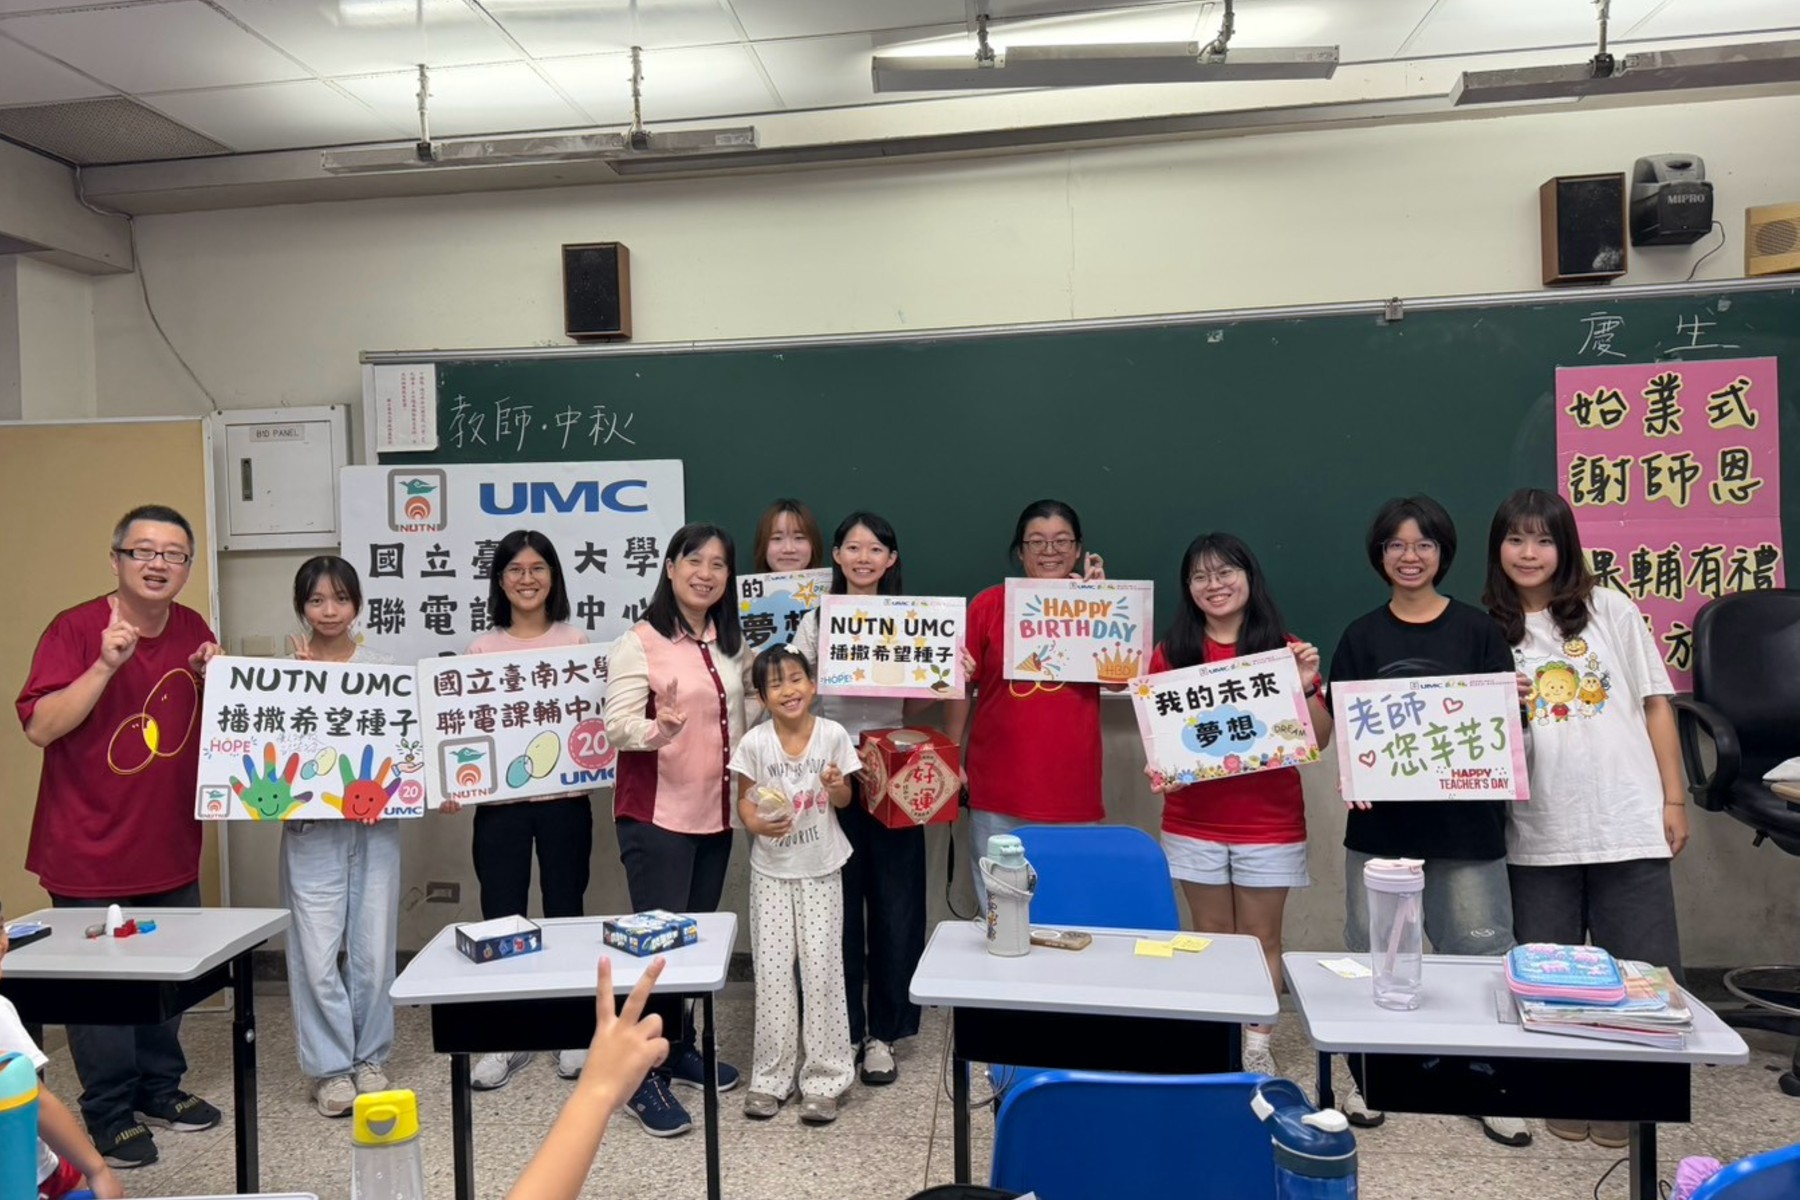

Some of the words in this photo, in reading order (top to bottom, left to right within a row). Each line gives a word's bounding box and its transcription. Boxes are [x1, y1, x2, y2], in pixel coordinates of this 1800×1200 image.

[1667, 193, 1706, 205] MIPRO
[1569, 372, 1757, 434] 始業式
[272, 428, 300, 439] PANEL
[1569, 448, 1763, 504] 謝師恩
[479, 479, 649, 515] UMC
[400, 523, 436, 533] NUTN
[368, 536, 660, 580] 國立臺大學
[1043, 597, 1113, 618] HAPPY
[831, 617, 894, 636] NUTN
[904, 618, 955, 637] UMC
[1019, 618, 1137, 643] BIRTHDAY
[230, 666, 328, 694] NUTN
[340, 671, 412, 697] UMC
[824, 674, 851, 684] HOPE
[1155, 672, 1280, 716] 我的未來
[217, 703, 418, 737] 播撒希望種子
[1348, 691, 1426, 740] 老師
[1194, 714, 1258, 749] 夢想
[1274, 724, 1307, 737] DREAM
[210, 739, 252, 753] HOPE
[577, 731, 609, 757] 20
[1381, 716, 1506, 777] 您辛苦了
[1439, 778, 1490, 790] TEACHER'S
[1491, 777, 1509, 790] DAY
[1451, 768, 1492, 778] HAPPY
[402, 785, 418, 799] 20
[453, 788, 487, 799] NUTN
[384, 806, 422, 816] UMC
